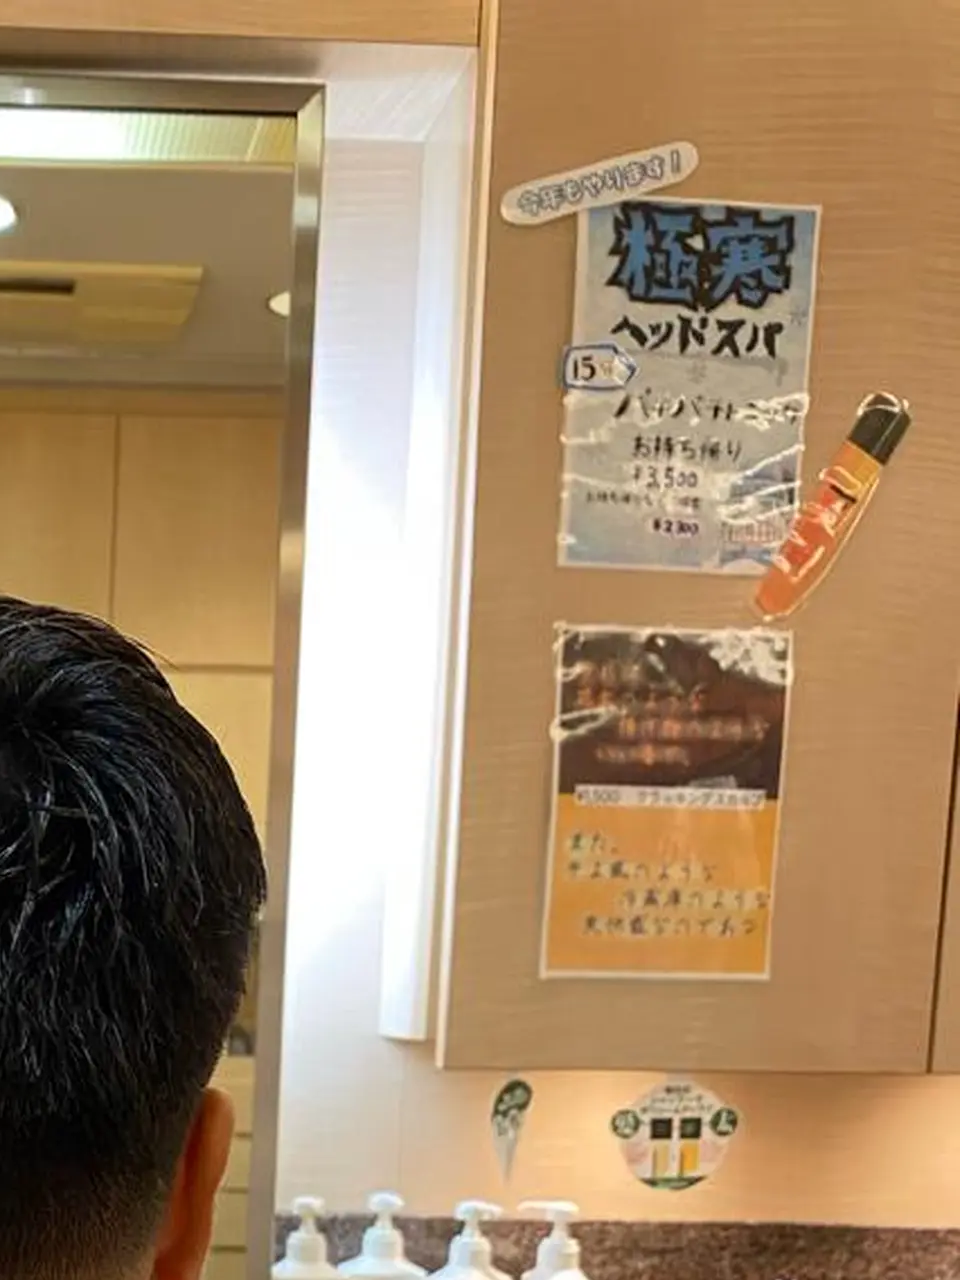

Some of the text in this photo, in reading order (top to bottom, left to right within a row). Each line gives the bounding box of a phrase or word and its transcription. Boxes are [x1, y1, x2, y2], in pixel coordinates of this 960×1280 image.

[605, 201, 795, 313] 極寒
[611, 314, 784, 359] ヘッドスパ
